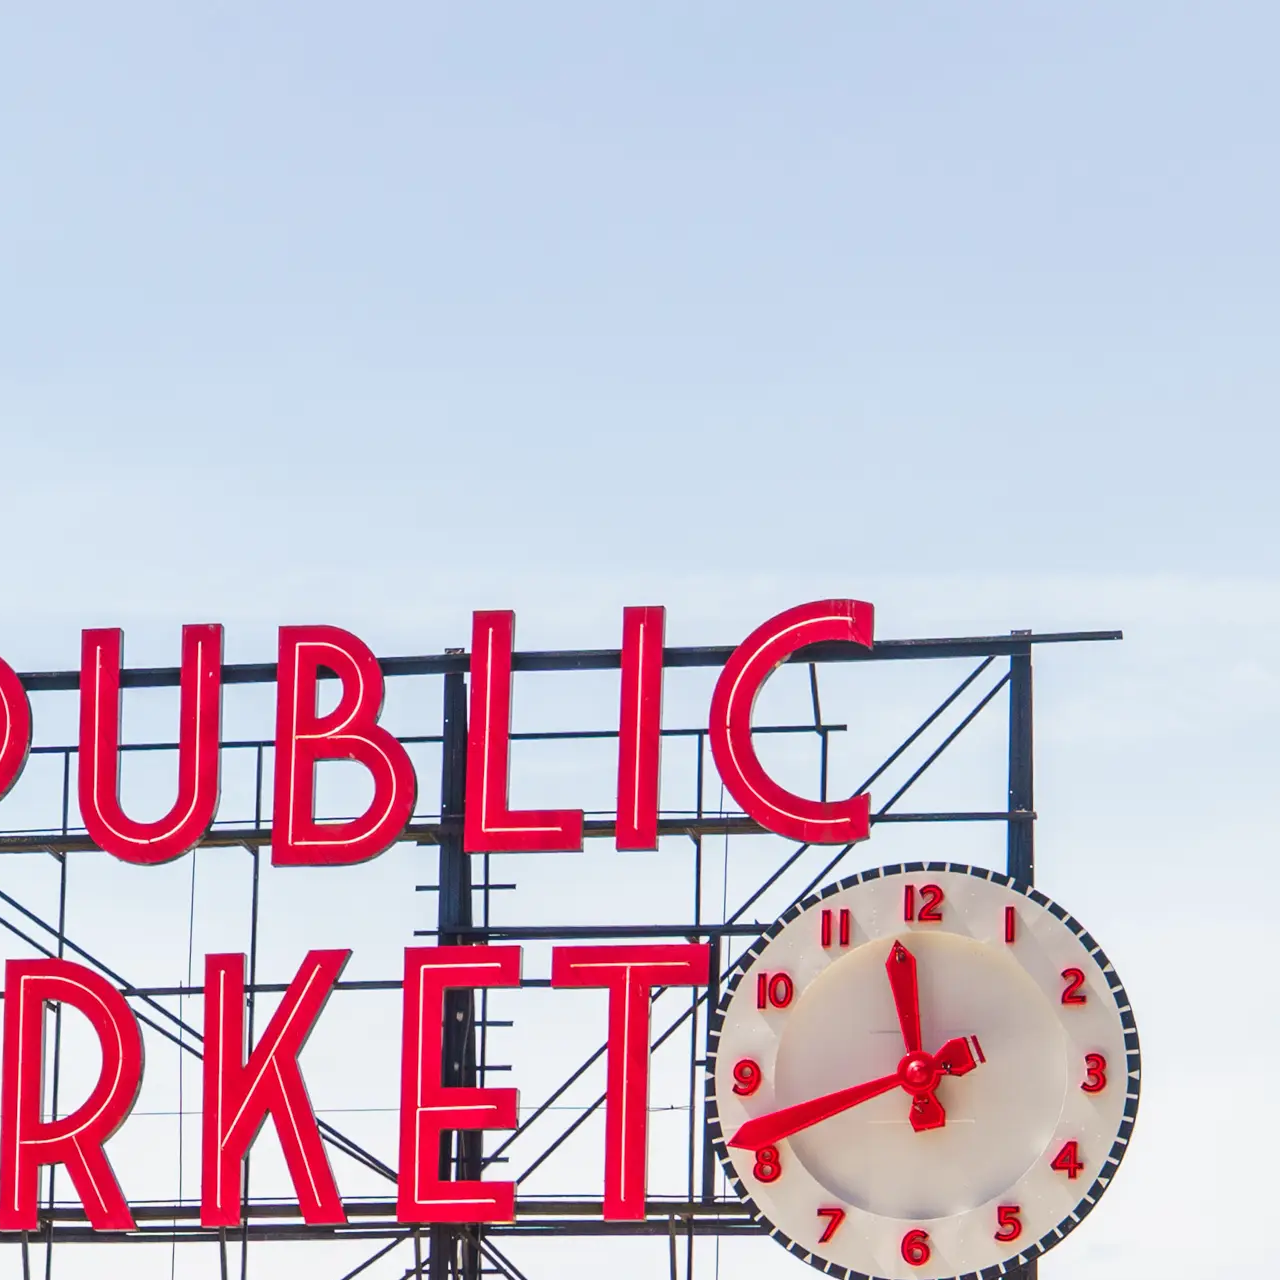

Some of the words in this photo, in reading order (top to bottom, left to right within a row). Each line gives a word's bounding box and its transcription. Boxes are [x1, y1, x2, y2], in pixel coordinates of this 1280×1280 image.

[904, 884, 944, 922] 12
[821, 909, 850, 947] 11
[1004, 906, 1015, 943] 1
[757, 973, 793, 1009] 10
[1061, 968, 1086, 1005] 2
[732, 1059, 761, 1096] 9
[1080, 1053, 1107, 1093] 3
[753, 1146, 782, 1183] 8
[1050, 1141, 1084, 1179] 4
[817, 1207, 846, 1243] 7
[994, 1206, 1022, 1241] 5
[901, 1229, 931, 1266] 6
